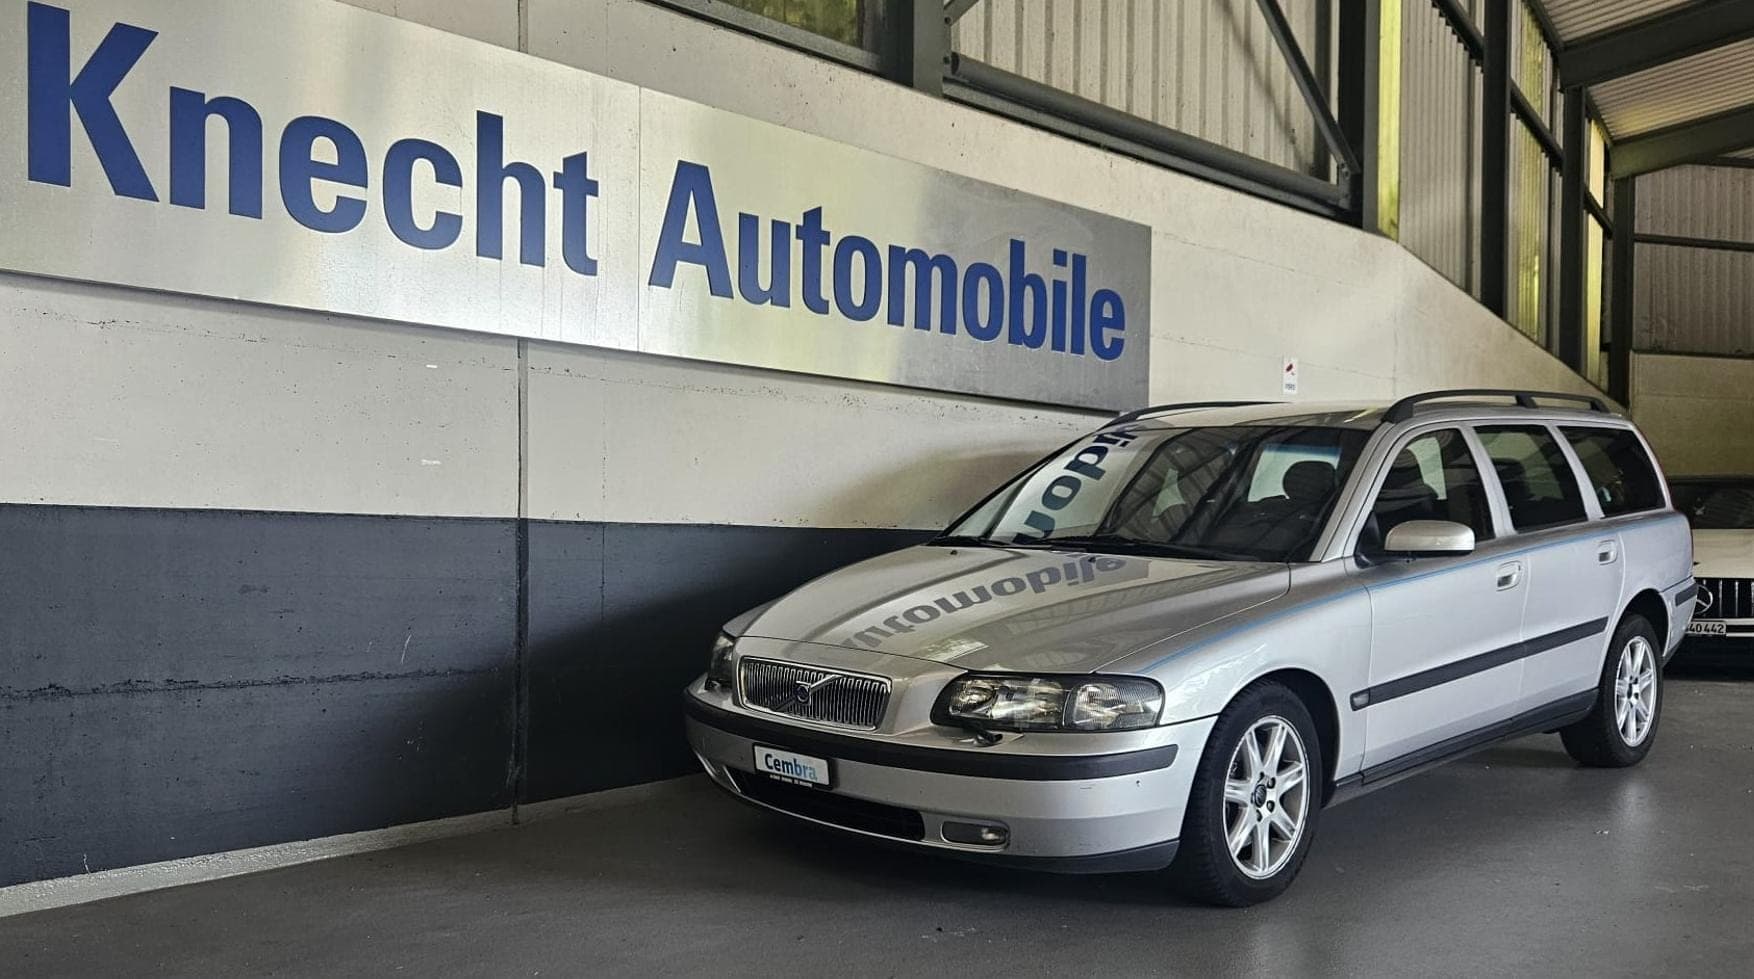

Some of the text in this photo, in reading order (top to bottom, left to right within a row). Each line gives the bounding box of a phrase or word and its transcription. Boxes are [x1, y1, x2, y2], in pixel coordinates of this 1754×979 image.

[27, 1, 1125, 361] Knecht Automobile
[764, 753, 818, 782] Cembra
